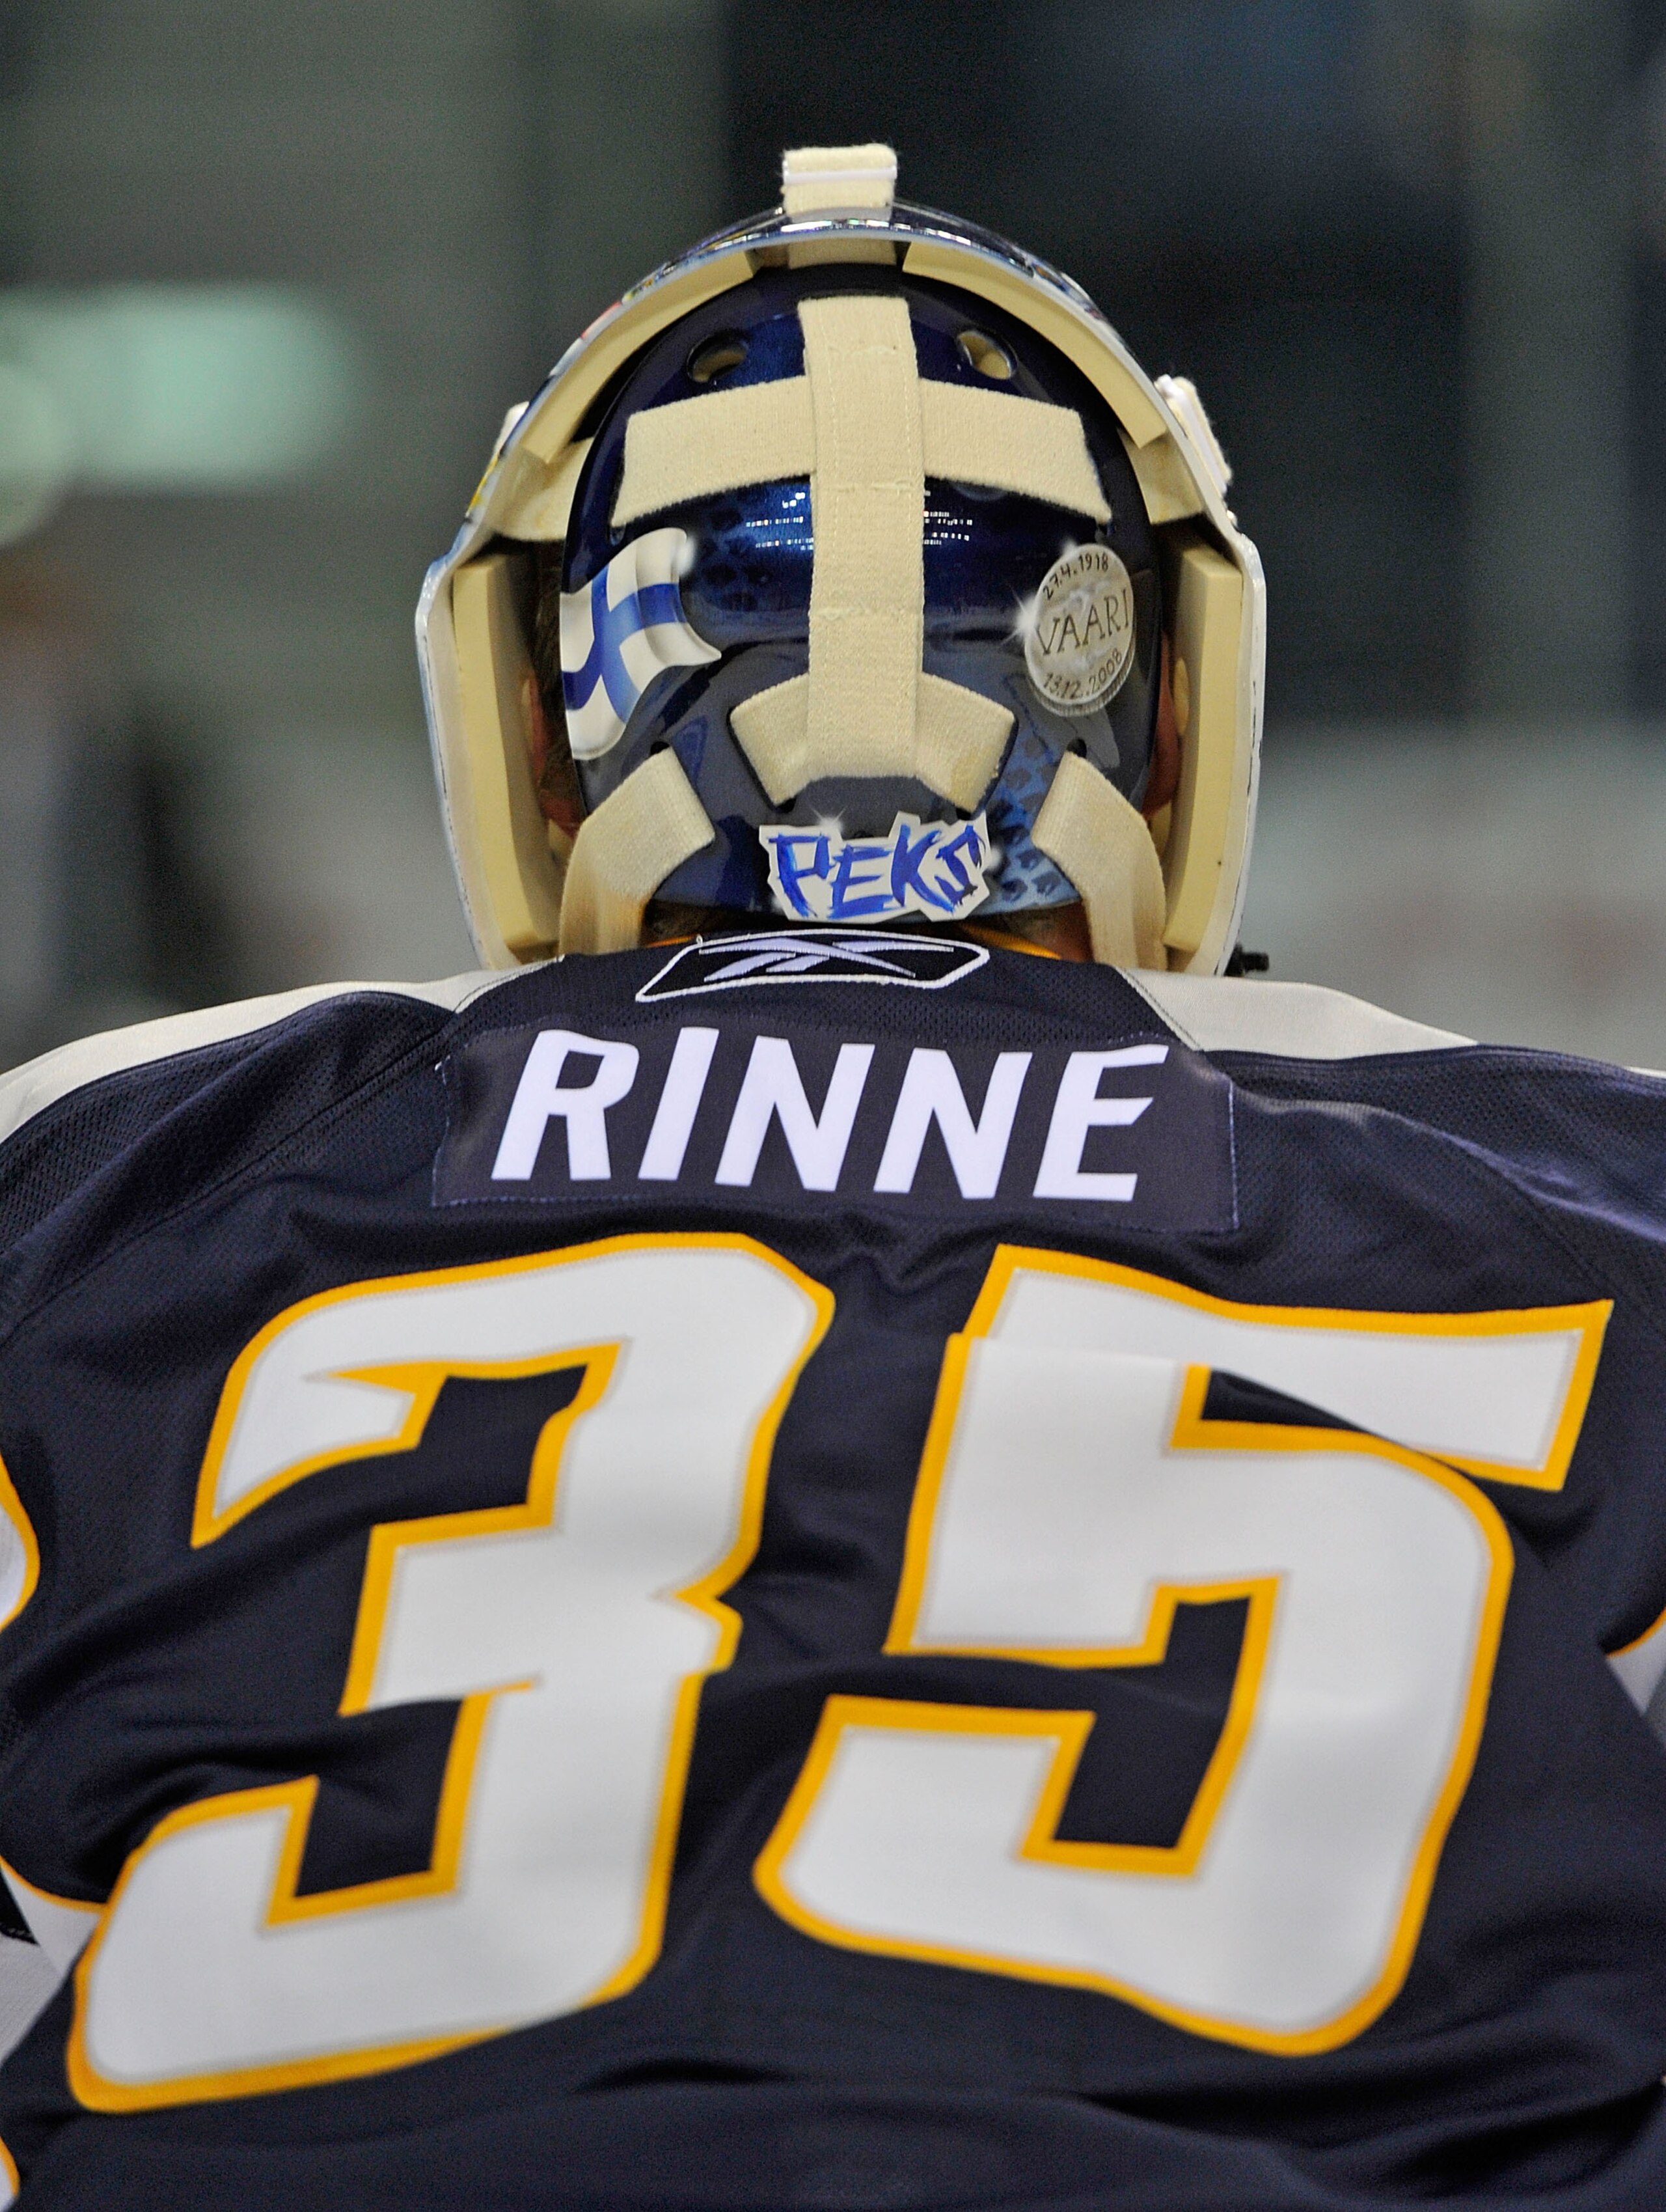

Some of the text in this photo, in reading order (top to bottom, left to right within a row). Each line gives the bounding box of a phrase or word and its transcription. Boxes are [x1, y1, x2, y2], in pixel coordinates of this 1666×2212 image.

[1036, 588, 1130, 656] VAARI
[1043, 552, 1109, 600] 27.4.1918
[769, 823, 987, 919] PEKS
[491, 1027, 1169, 1200] RINNE
[66, 1231, 1614, 2112] 35
